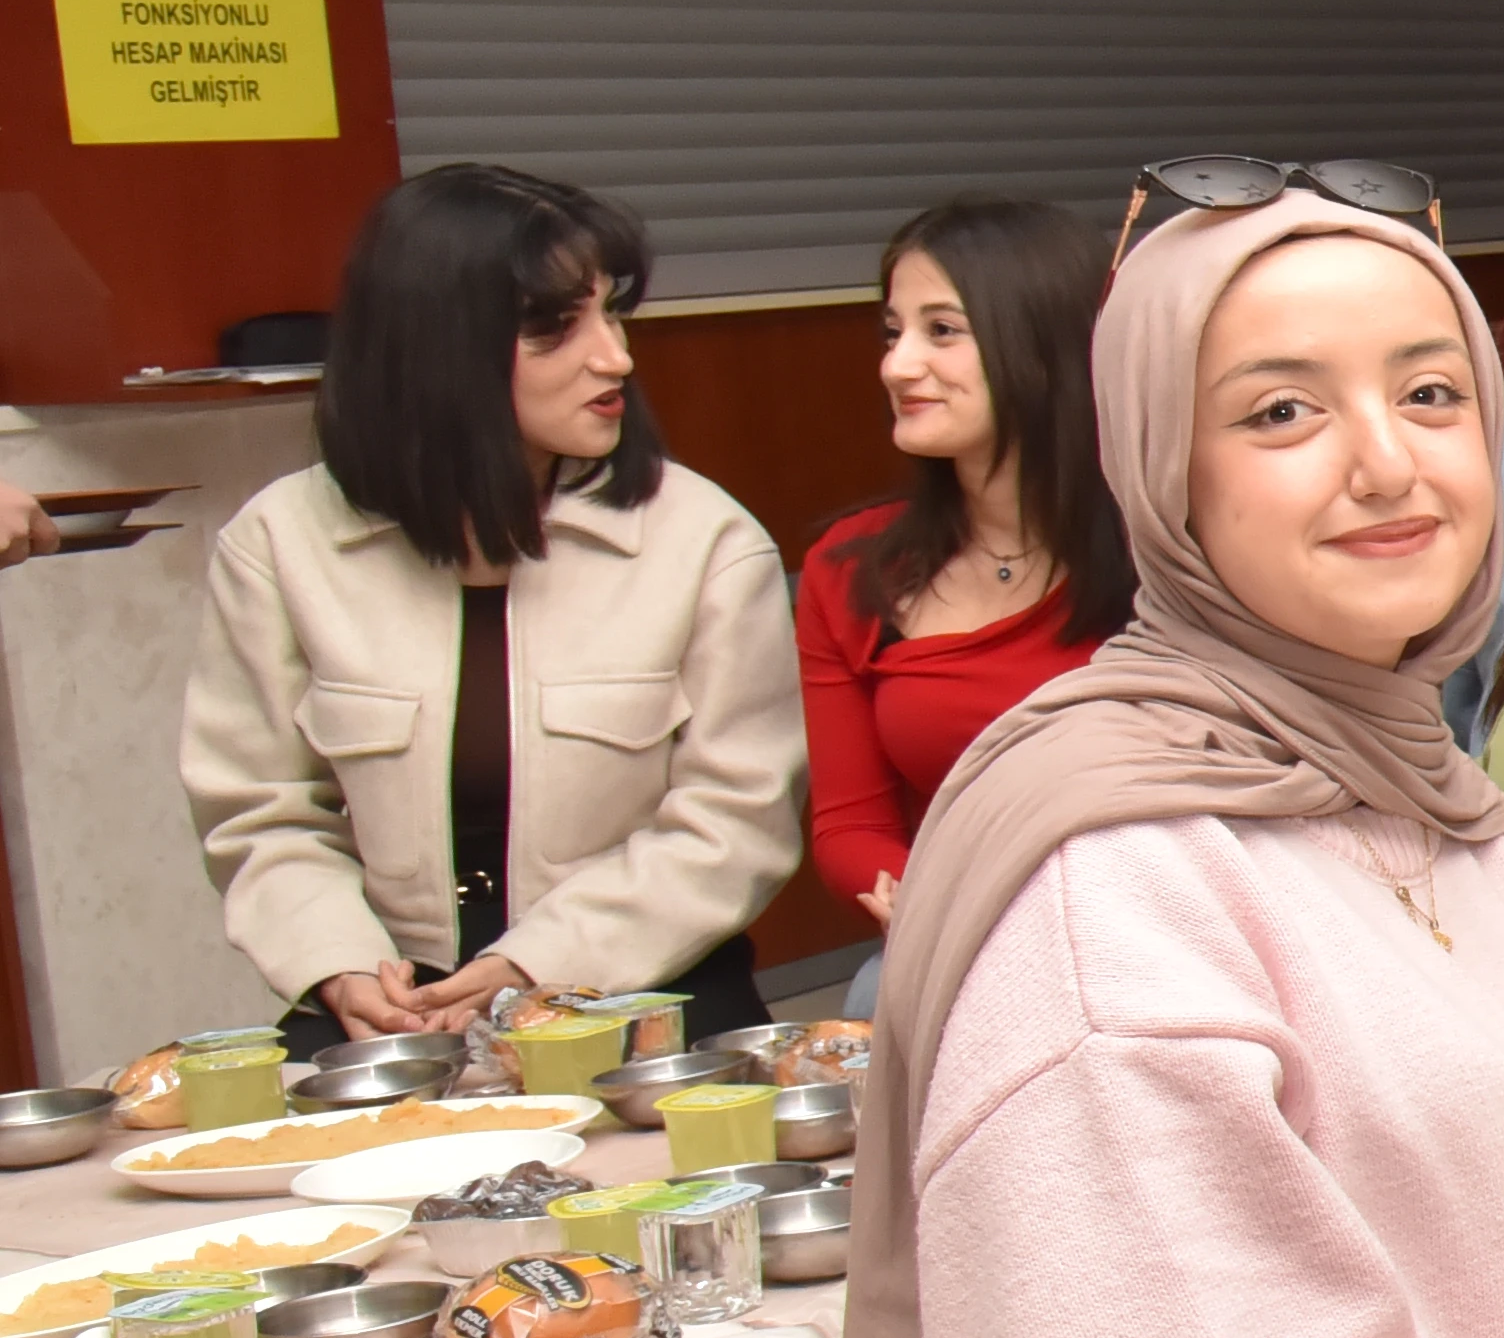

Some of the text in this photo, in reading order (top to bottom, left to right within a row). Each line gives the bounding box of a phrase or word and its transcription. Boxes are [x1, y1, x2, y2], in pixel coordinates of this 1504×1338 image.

[111, 36, 288, 64] HESAP MAKİNASI
[150, 73, 261, 108] GELMİŞTİR
[530, 1259, 581, 1303] DORUK
